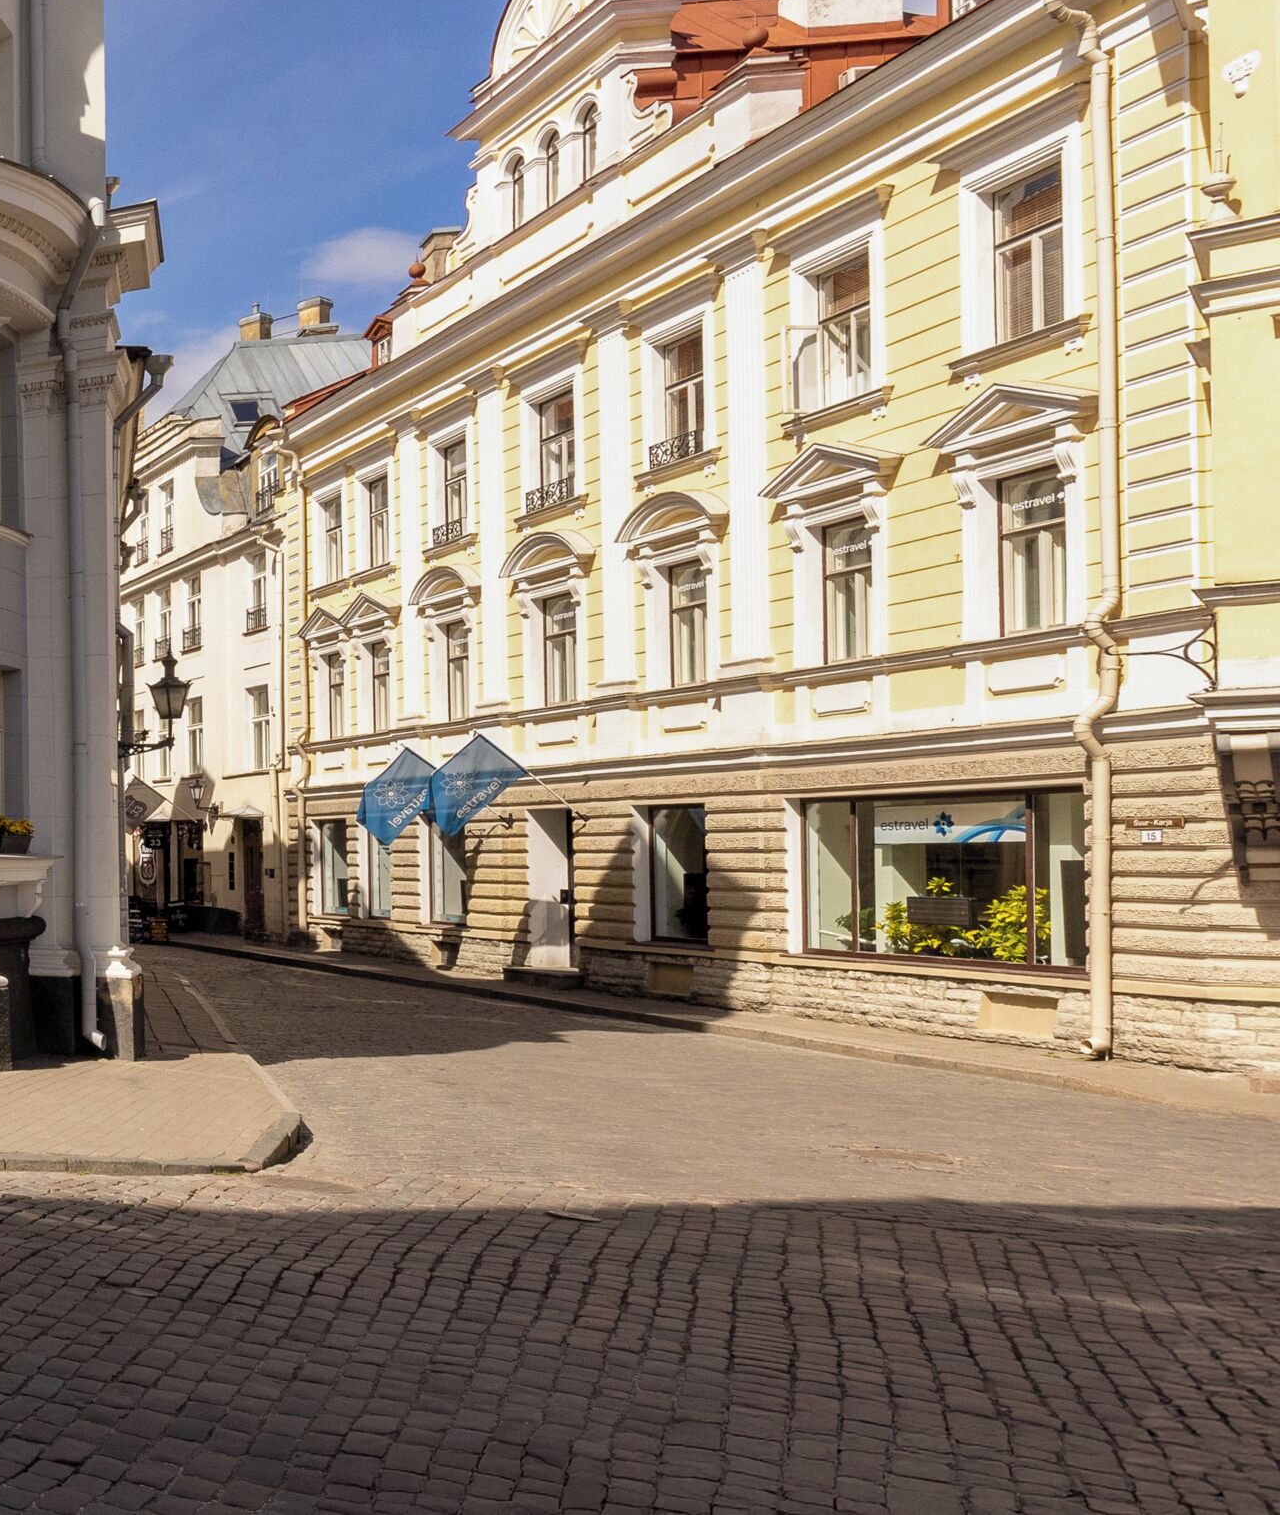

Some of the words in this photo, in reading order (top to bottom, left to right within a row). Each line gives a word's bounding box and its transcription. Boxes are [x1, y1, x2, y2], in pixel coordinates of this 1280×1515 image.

[1012, 493, 1055, 511] estravel
[833, 539, 867, 556] estravel
[677, 581, 705, 593] estravel
[456, 777, 503, 819] estravel
[880, 818, 929, 831] estravel
[1146, 832, 1157, 841] 15
